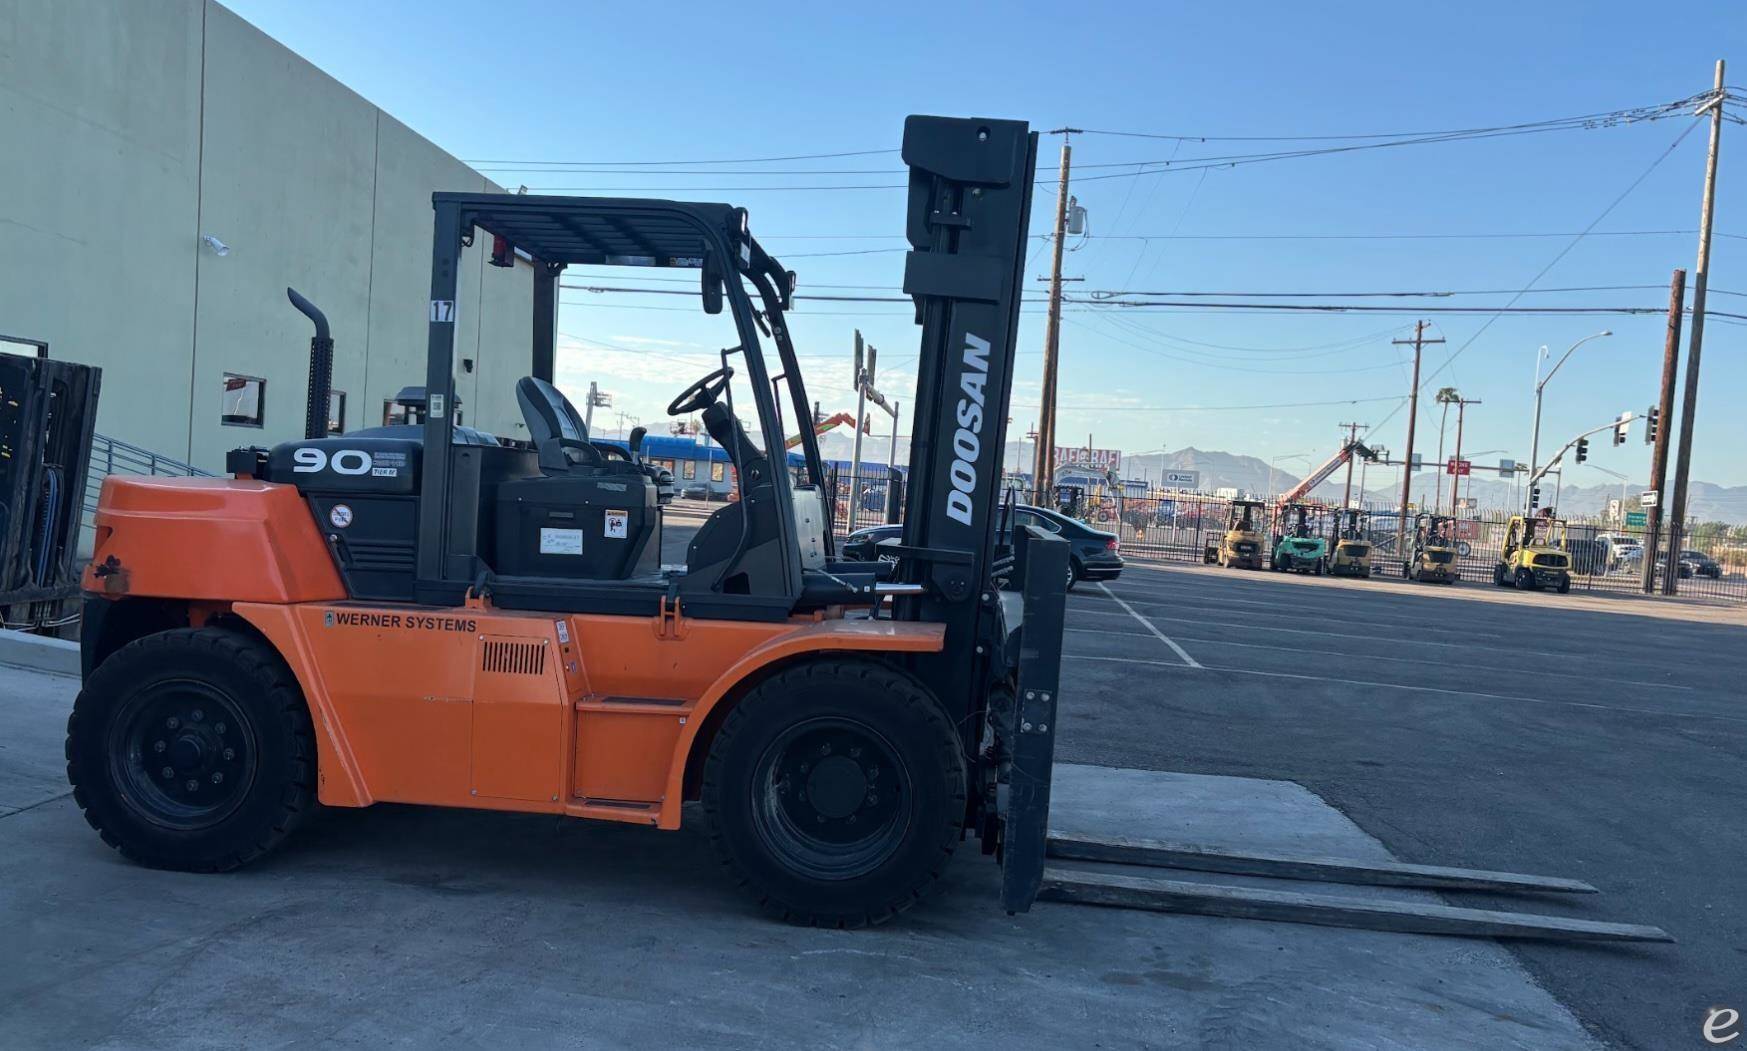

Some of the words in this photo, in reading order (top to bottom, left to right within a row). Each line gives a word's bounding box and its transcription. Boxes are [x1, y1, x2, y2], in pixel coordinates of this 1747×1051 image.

[433, 302, 452, 321] 17
[946, 332, 991, 526] DOOSAN
[293, 447, 372, 475] 90
[336, 613, 401, 628] WERNER
[405, 616, 477, 632] SYSTEMS
